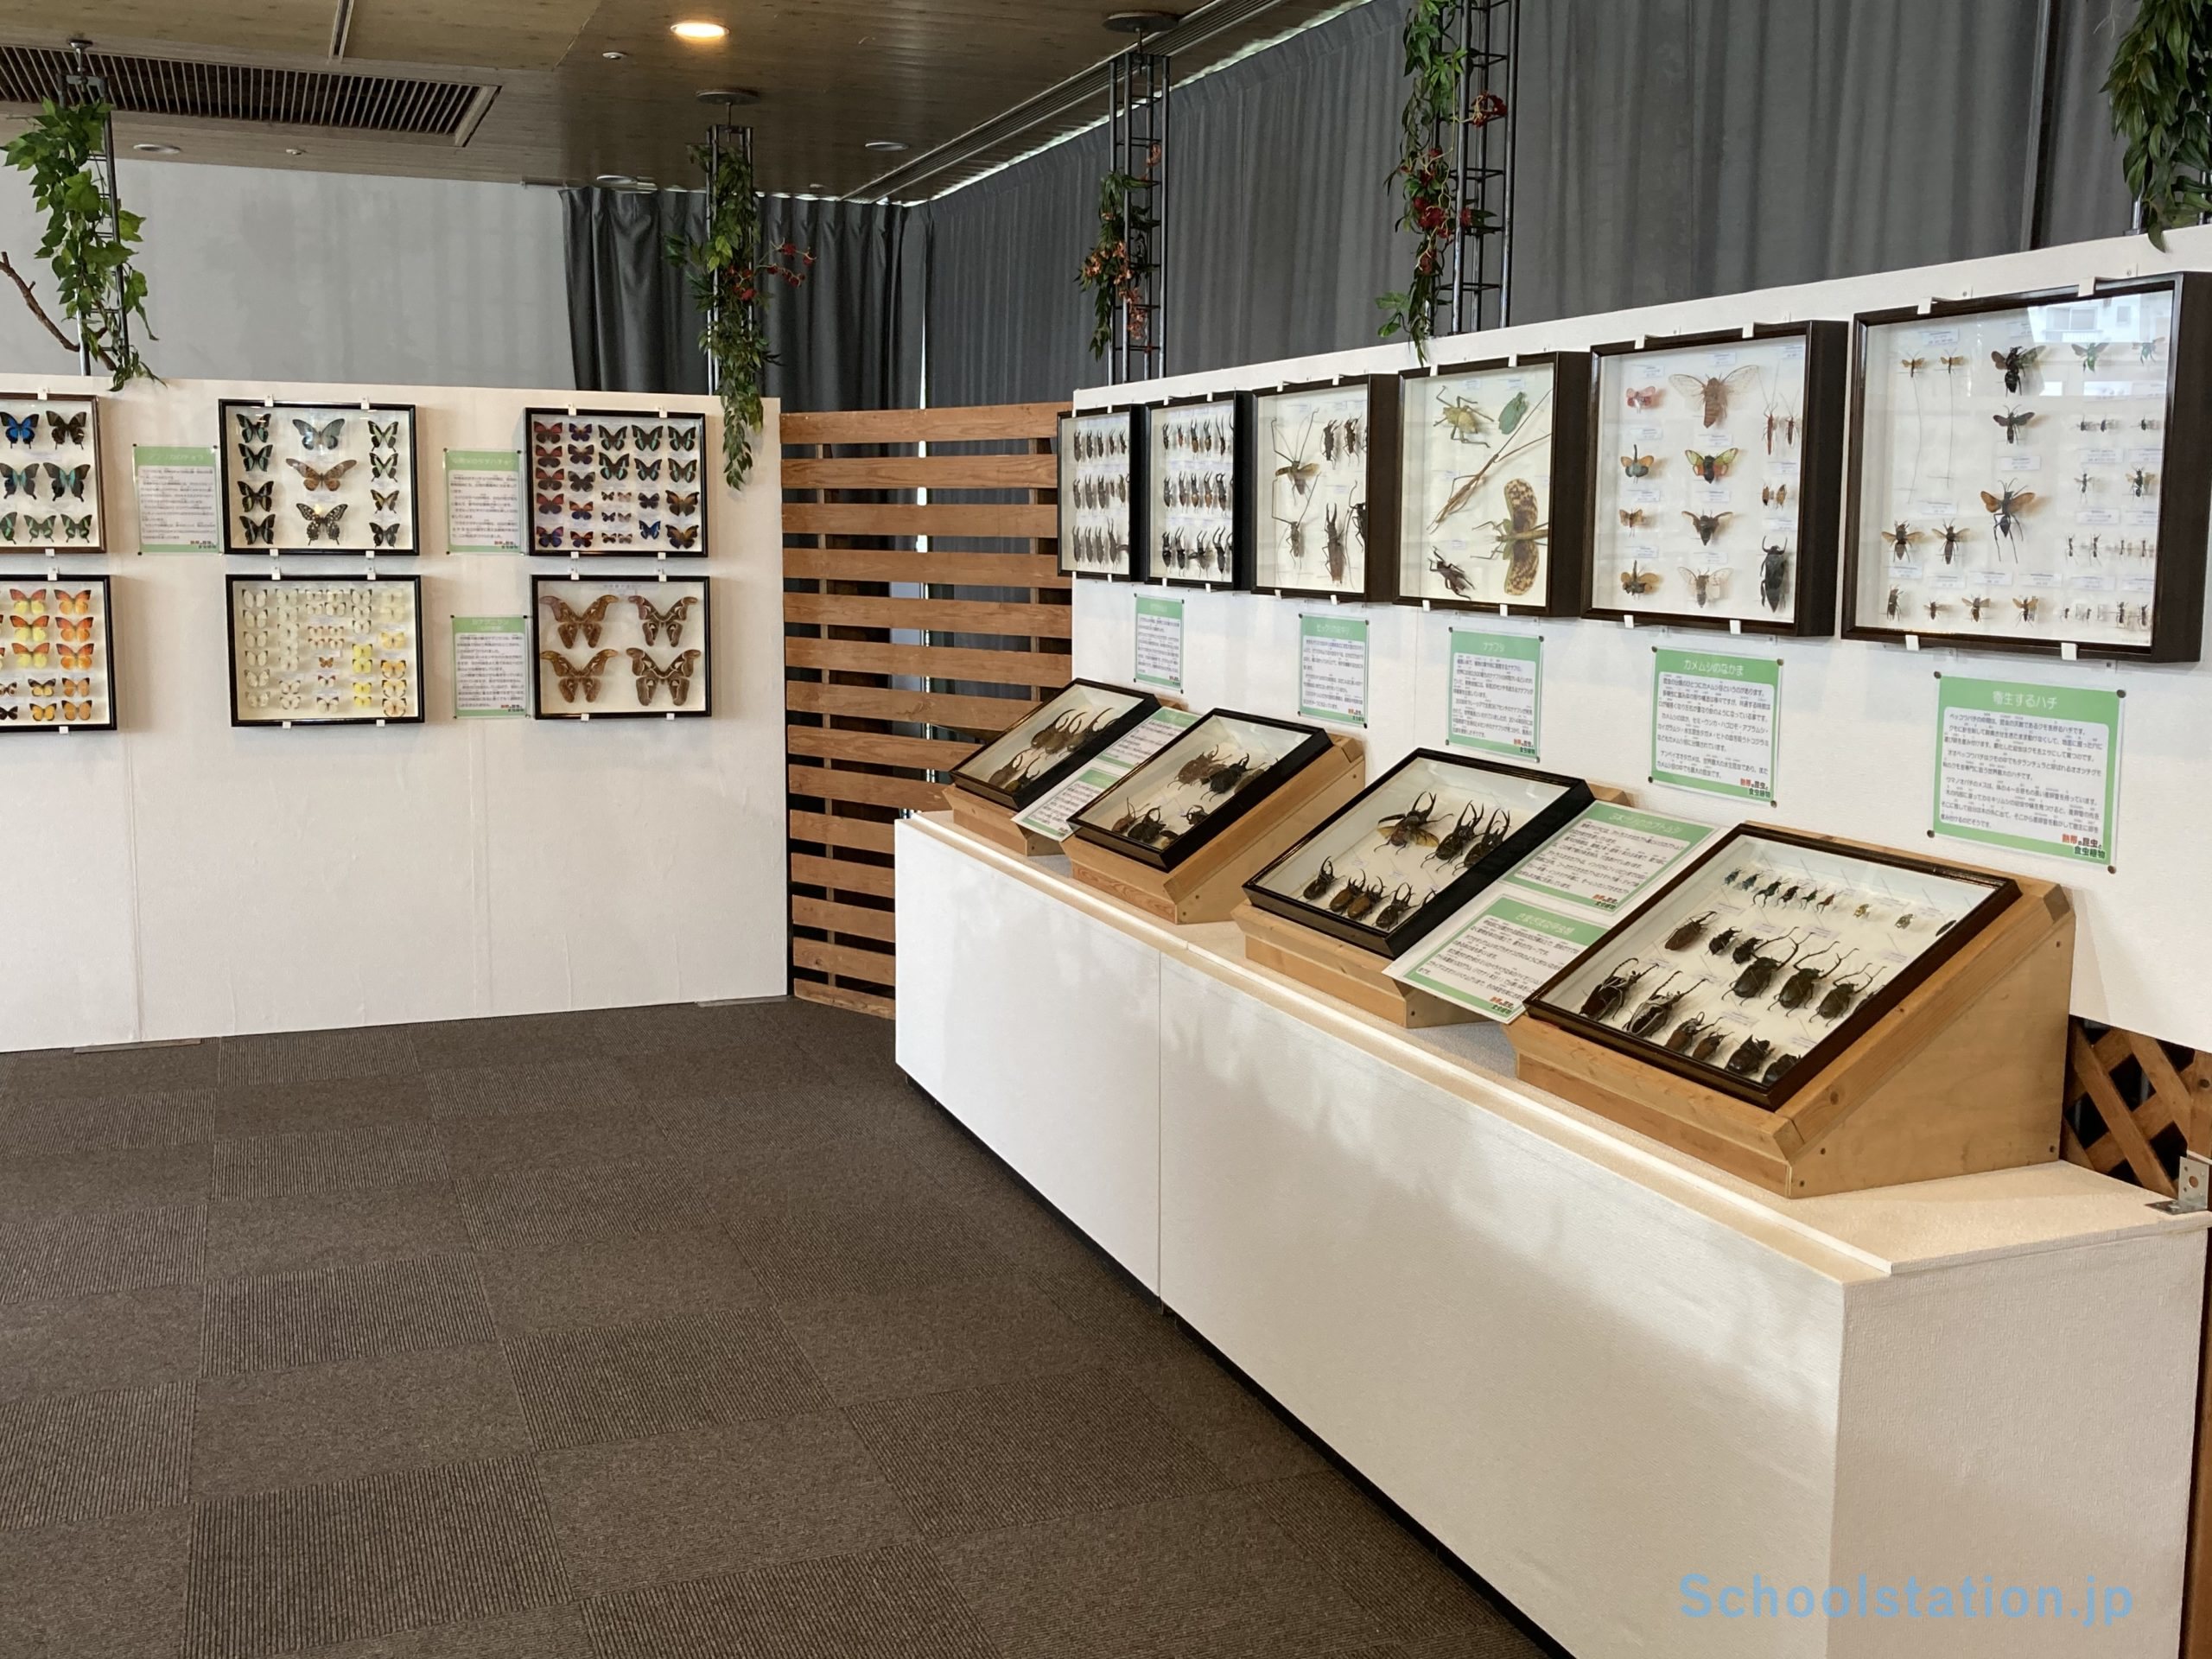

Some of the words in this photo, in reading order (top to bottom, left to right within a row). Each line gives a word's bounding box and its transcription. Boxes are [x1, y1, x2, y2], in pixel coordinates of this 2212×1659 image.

[1684, 660, 1745, 677] カメムシのなかま
[1993, 690, 2057, 710] 寄生するハチ
